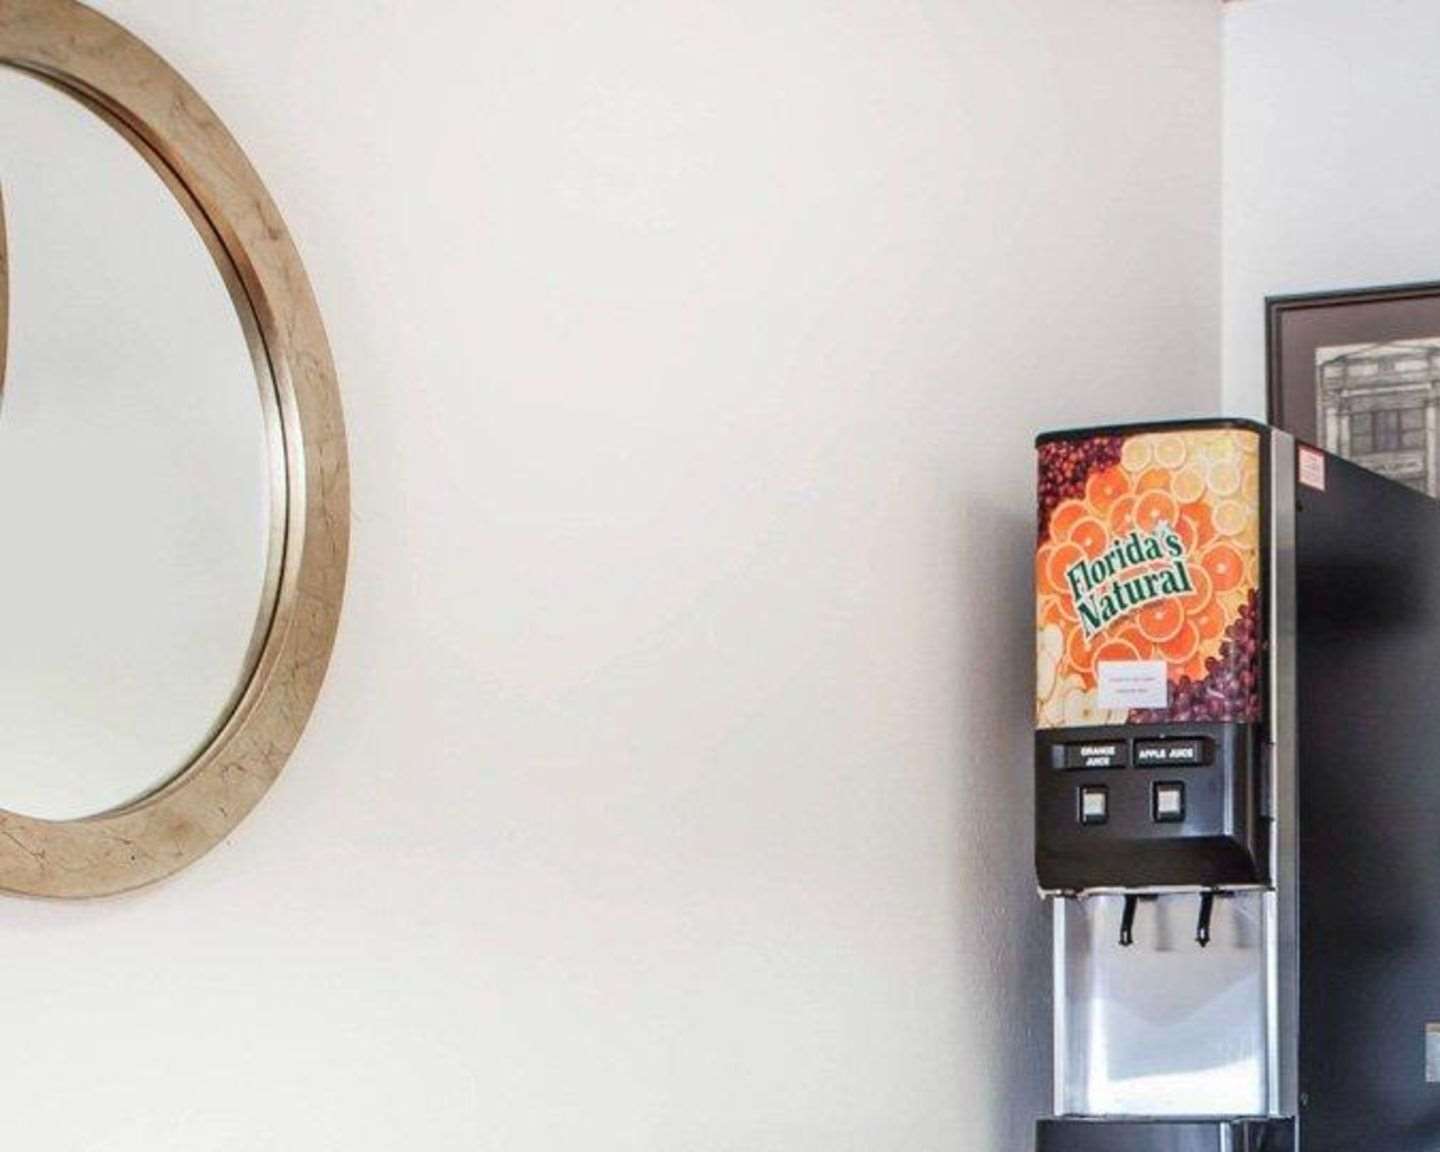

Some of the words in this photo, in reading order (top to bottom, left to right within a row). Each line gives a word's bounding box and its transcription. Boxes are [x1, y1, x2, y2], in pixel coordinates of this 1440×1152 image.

[1067, 527, 1183, 601] Florida's
[1078, 560, 1193, 638] Natural
[1139, 748, 1166, 759] APPLE
[1169, 748, 1194, 758] JUICE
